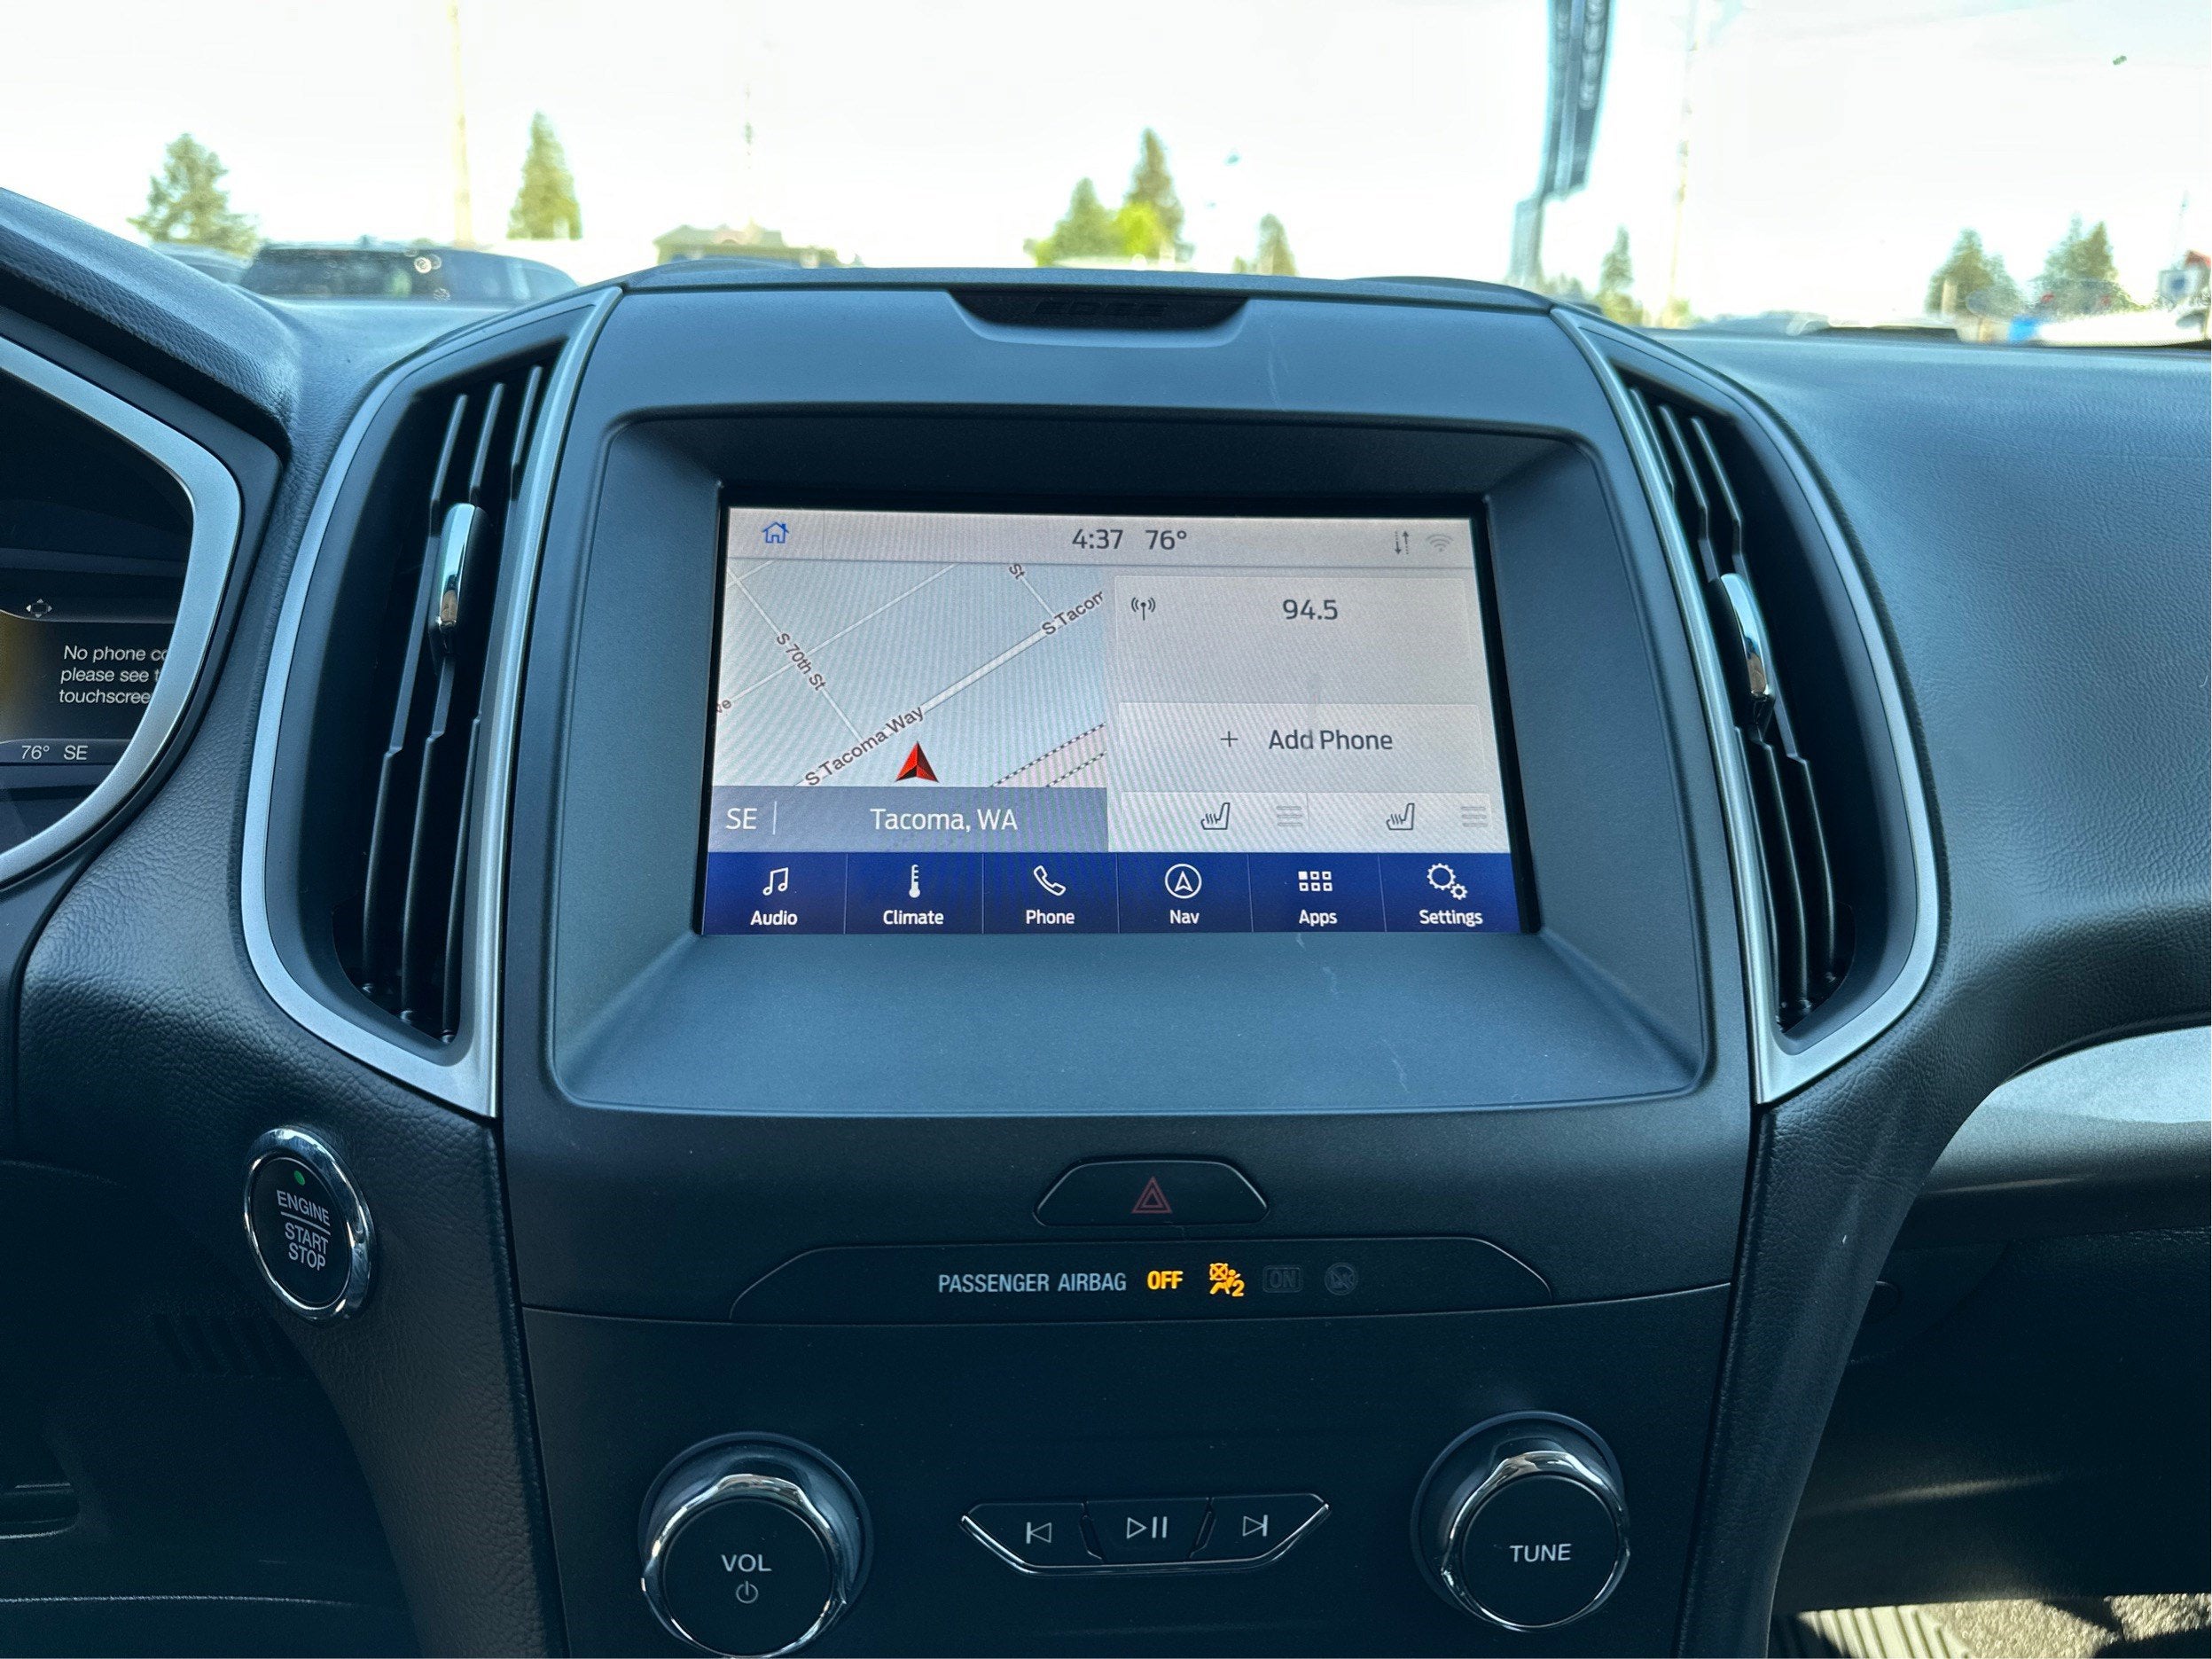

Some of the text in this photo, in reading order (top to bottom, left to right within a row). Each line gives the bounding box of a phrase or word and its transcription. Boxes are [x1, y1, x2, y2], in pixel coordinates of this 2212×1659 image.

[1072, 528, 1187, 551] 4:37 76°
[1009, 563, 1026, 580] St
[1282, 599, 1339, 621] 94.5
[1042, 622, 1057, 635] S
[64, 645, 88, 661] No
[92, 646, 146, 663] phone
[777, 632, 826, 691] S 70th St
[60, 667, 114, 684] please
[120, 672, 149, 683] see
[805, 707, 924, 786] S Tacoma Way
[1269, 730, 1393, 750] Add Phone
[21, 745, 89, 761] 76° SE
[725, 808, 1019, 833] SE Tacoma, WA
[750, 910, 798, 926] Audio
[883, 910, 944, 925] Climate
[1025, 909, 1075, 925] Phone
[1169, 909, 1200, 925] Nav
[1299, 909, 1338, 928] Apps
[1419, 909, 1483, 928] Settings
[276, 1189, 331, 1226] ENGINE
[285, 1222, 329, 1255] START
[288, 1242, 326, 1272] STOP
[938, 1270, 1184, 1293] PASSENGER AIRBAG OFF
[1270, 1270, 1297, 1288] ON
[721, 1553, 772, 1572] VOL
[1509, 1543, 1572, 1563] TUNE
